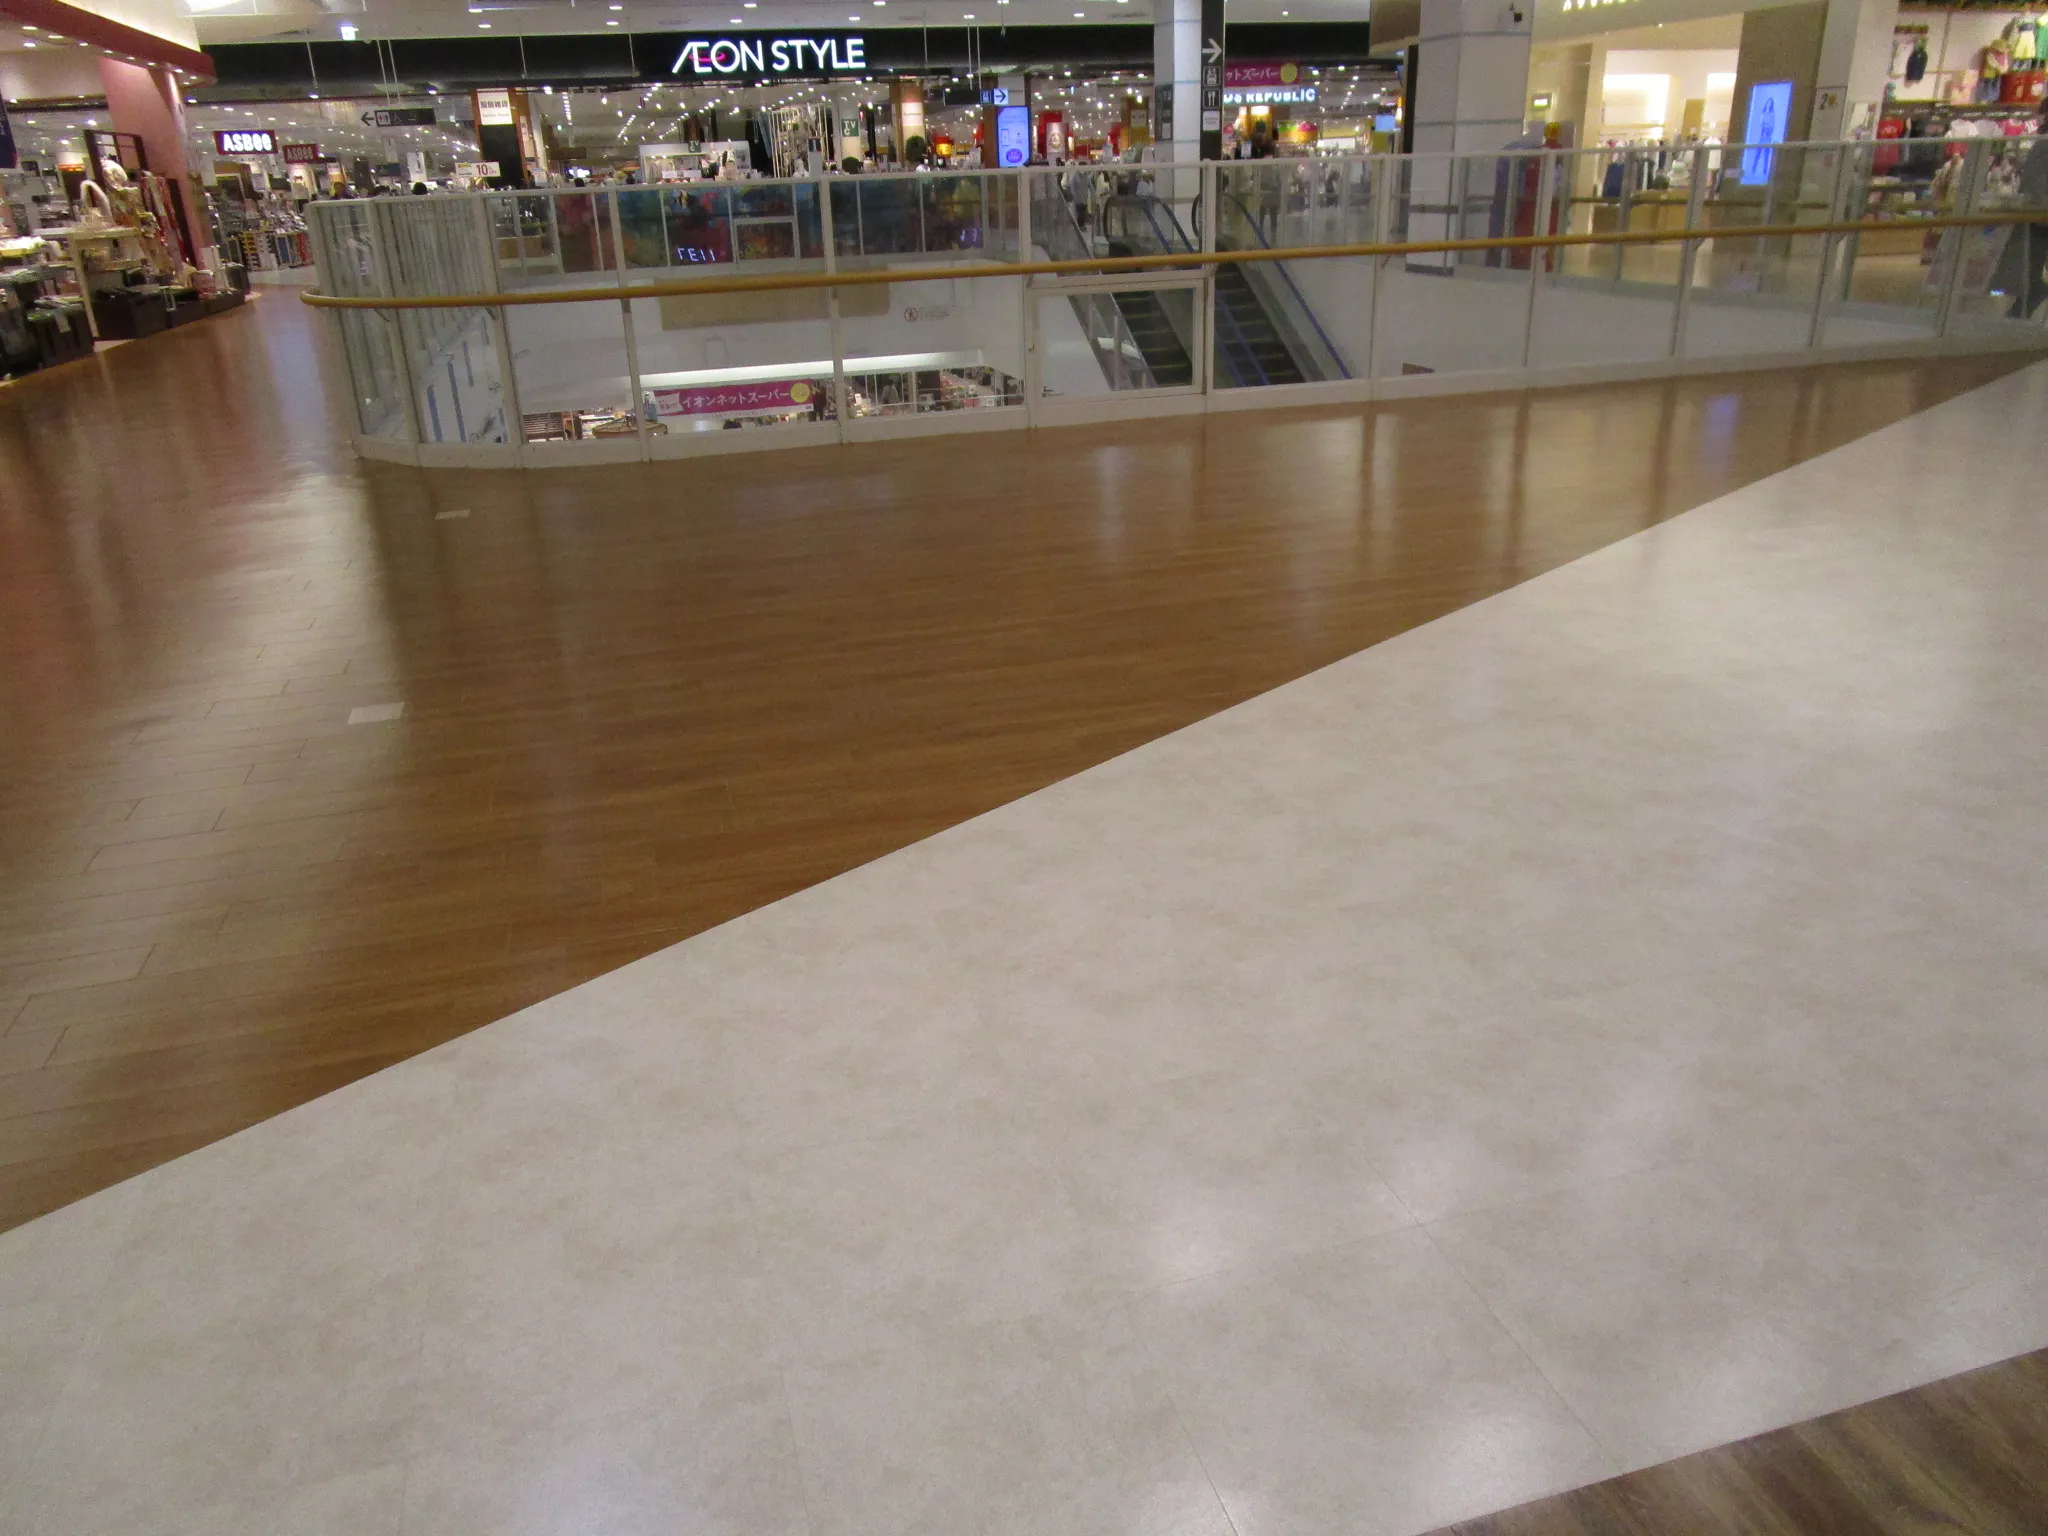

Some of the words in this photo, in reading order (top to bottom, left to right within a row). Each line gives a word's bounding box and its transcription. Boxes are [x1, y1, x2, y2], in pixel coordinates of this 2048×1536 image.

[771, 39, 866, 71] STYLE
[682, 388, 790, 409] イオンネットスーパー
